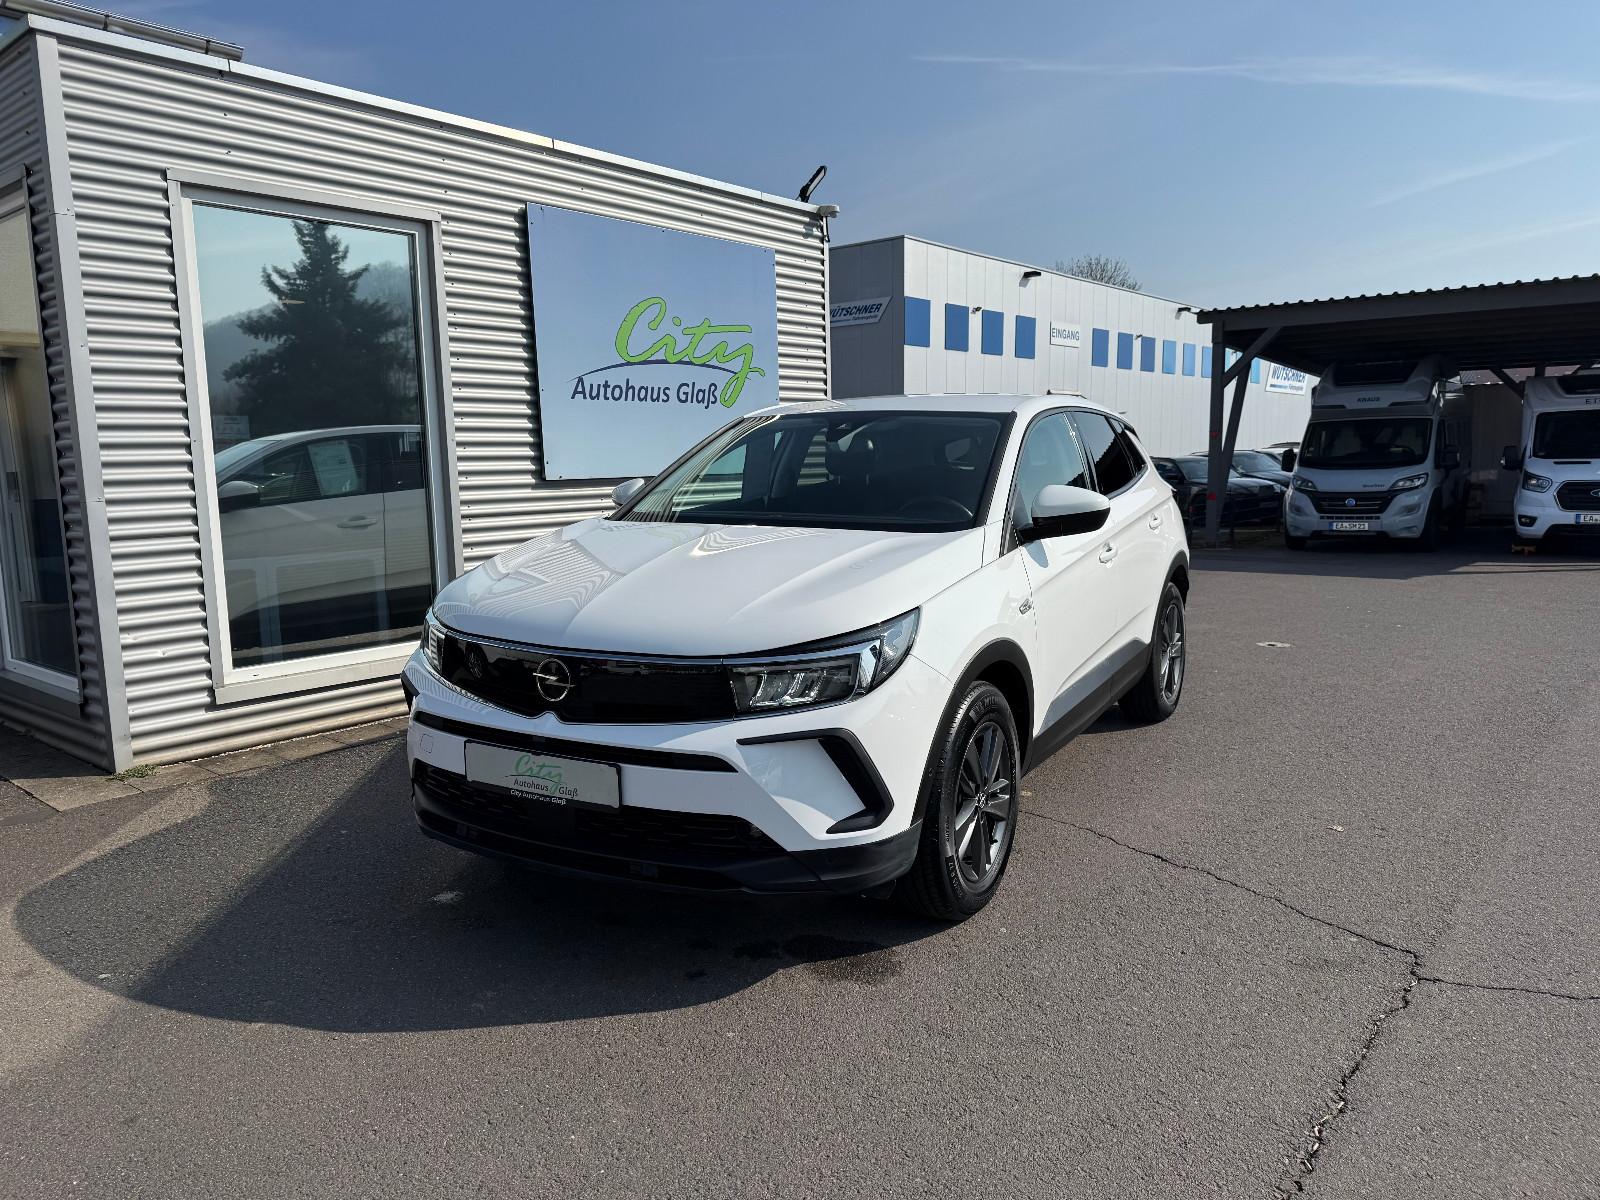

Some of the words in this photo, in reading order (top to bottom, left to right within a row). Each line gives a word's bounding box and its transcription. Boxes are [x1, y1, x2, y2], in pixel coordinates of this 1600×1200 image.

[1052, 327, 1080, 341] EINGANG
[615, 297, 765, 408] City
[571, 377, 670, 403] Autohaus
[677, 383, 718, 409] Glaß
[515, 754, 562, 795] City
[510, 789, 522, 797] City
[513, 778, 548, 791] Autohaus
[558, 786, 578, 798] Glaß
